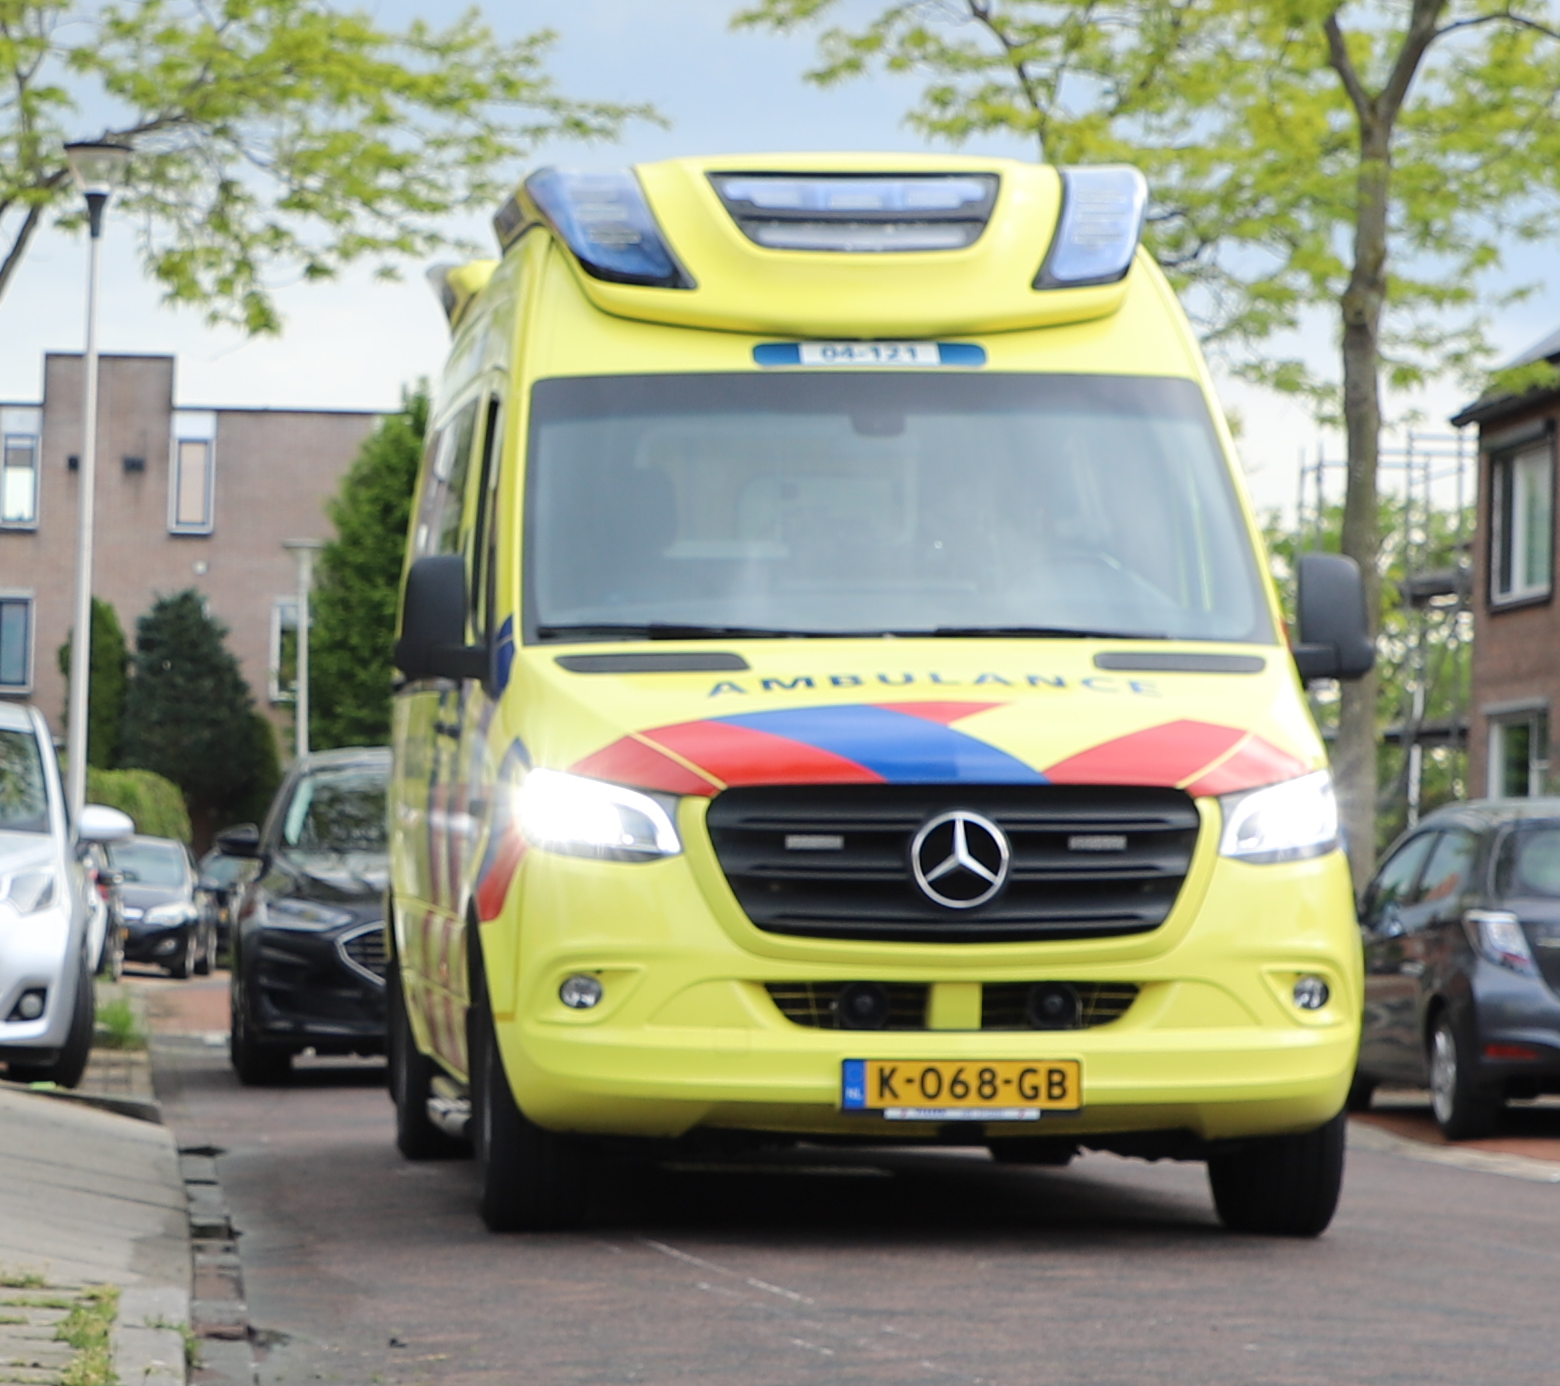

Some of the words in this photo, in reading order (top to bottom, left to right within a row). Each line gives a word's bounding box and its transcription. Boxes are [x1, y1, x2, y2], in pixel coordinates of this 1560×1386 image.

[821, 344, 918, 362] 04-121
[707, 671, 1162, 698] AMBULANCE
[877, 1067, 1068, 1101] K-068-GB
